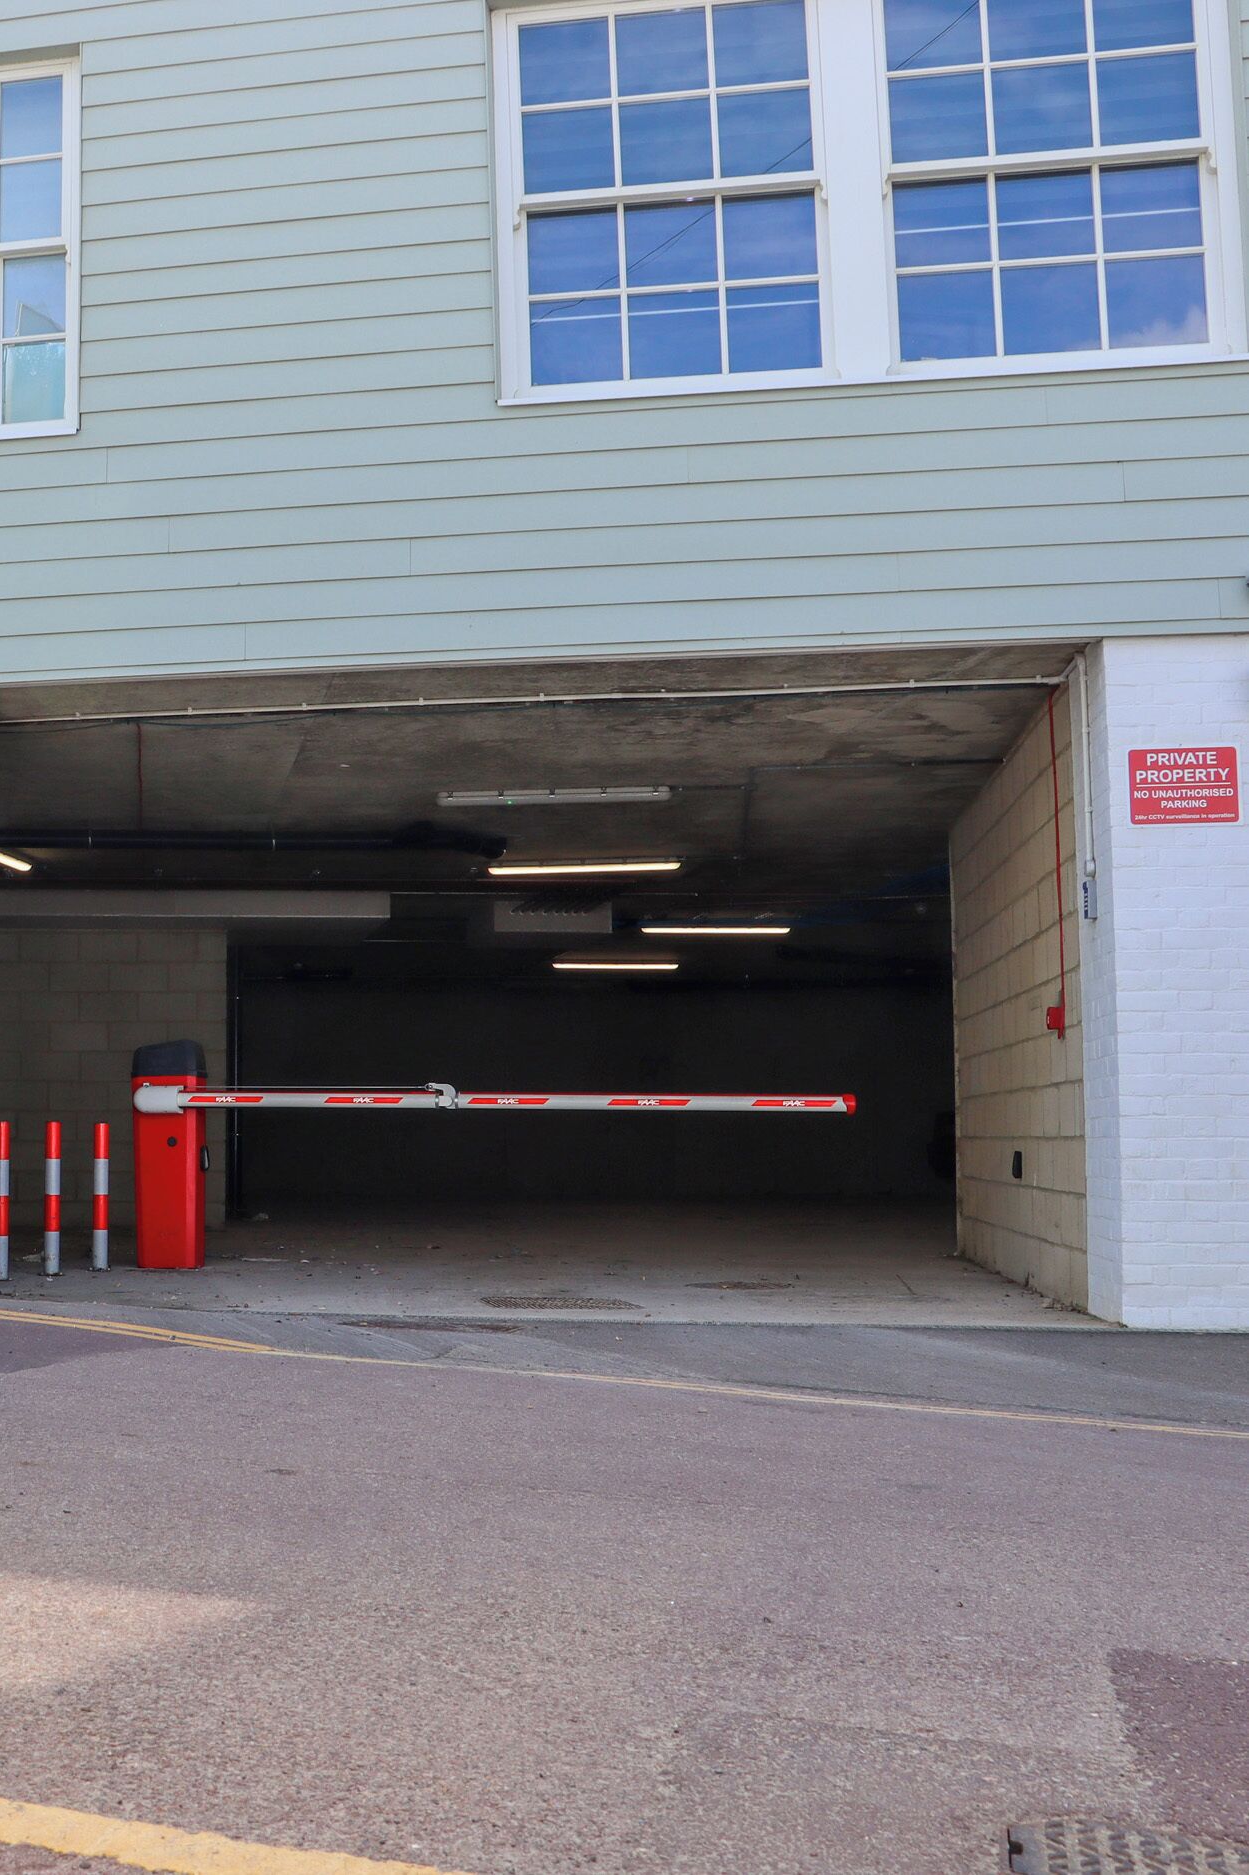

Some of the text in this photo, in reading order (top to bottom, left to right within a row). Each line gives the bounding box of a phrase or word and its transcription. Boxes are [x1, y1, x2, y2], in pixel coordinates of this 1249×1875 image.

[1146, 751, 1217, 766] PRIVATE
[1135, 767, 1230, 783] PROPERTY
[1133, 788, 1234, 798] NO UNAUTHORISED
[1160, 799, 1208, 808] PARKING
